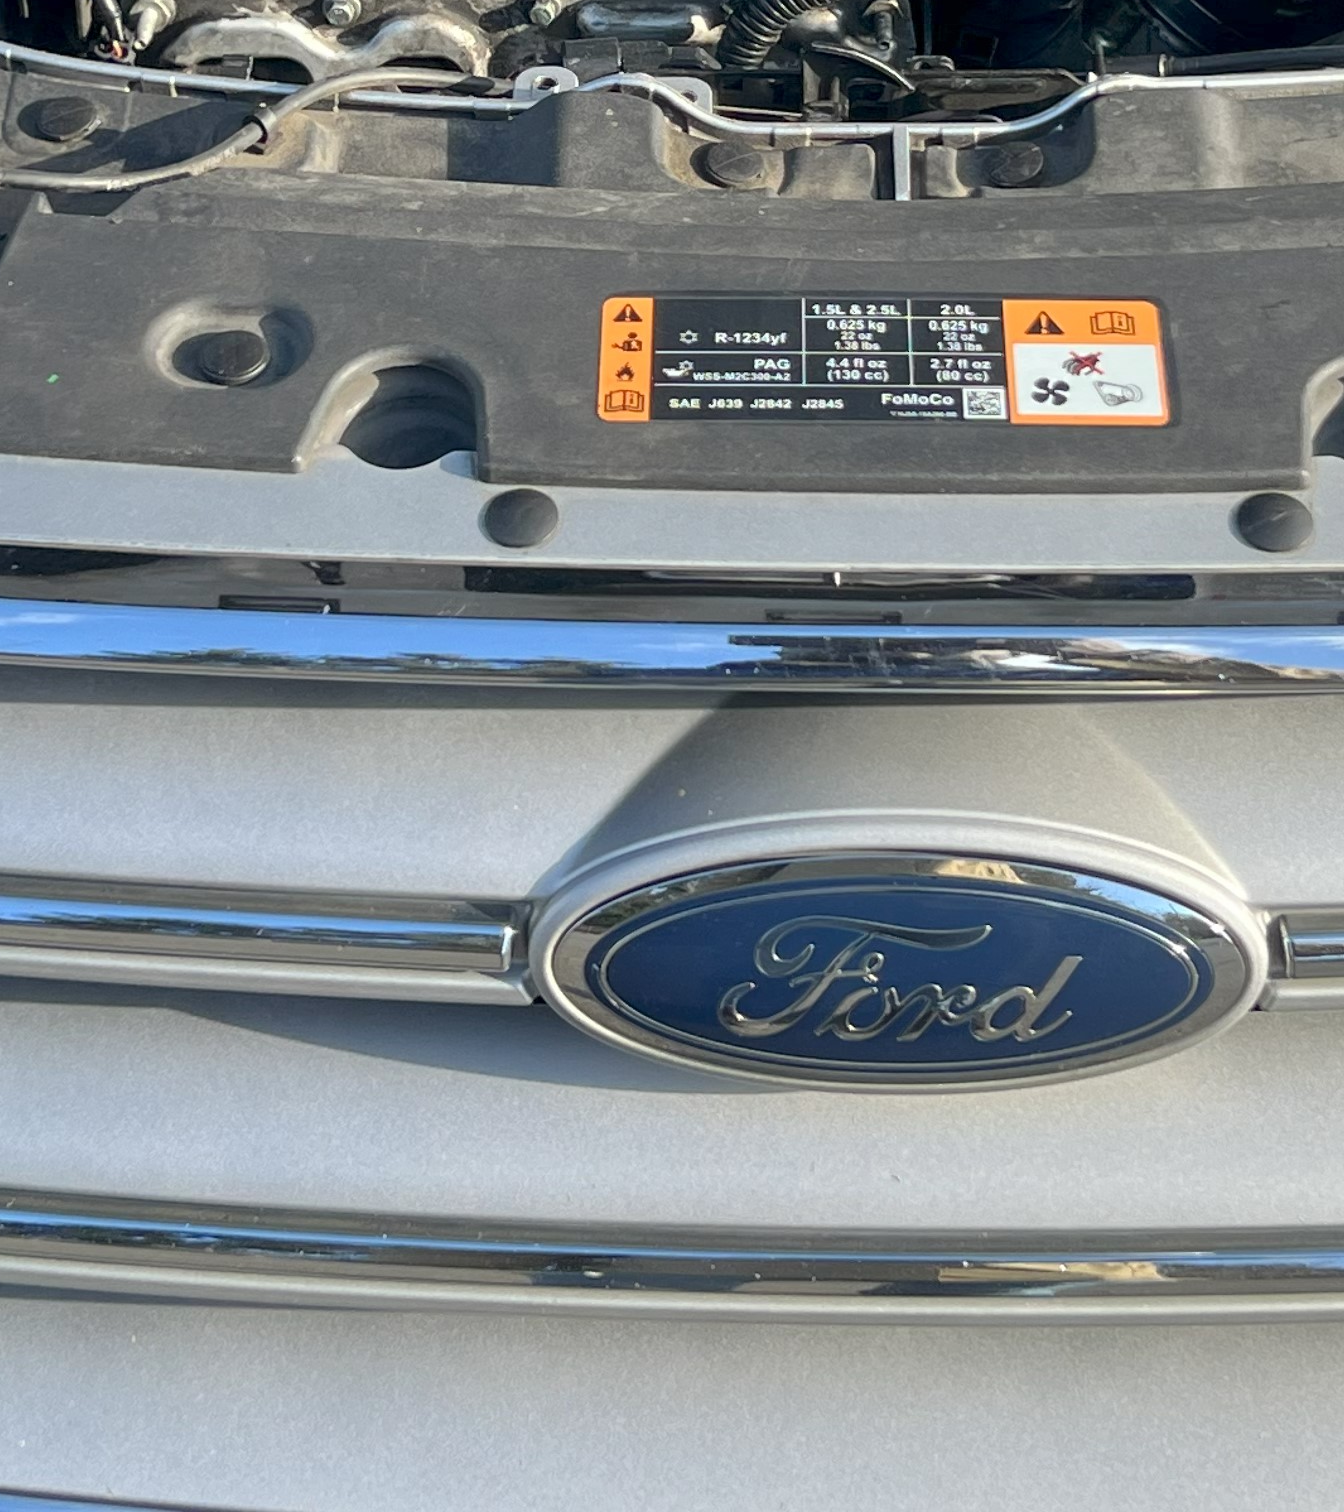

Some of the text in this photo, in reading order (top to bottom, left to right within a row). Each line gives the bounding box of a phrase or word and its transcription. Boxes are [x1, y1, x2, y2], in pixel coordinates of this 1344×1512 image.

[811, 303, 902, 316] 1.5L & 2.5L
[940, 304, 976, 316] 2.0L
[826, 319, 887, 333] 0.625 kg
[928, 320, 989, 334] 0.625 kg
[714, 331, 789, 346] R-1234yf
[840, 331, 873, 341] 22 oz
[943, 332, 957, 341] 22
[861, 341, 881, 351] lbs
[964, 342, 983, 352] lbs
[753, 358, 792, 370] PAG
[825, 358, 887, 369] 4.4 fl oz
[930, 358, 992, 370] 2.7 fl oz
[827, 369, 890, 383] (130 cc)
[936, 370, 990, 383] (80 cc)
[668, 398, 701, 409] SAE
[708, 398, 744, 409] J639
[750, 398, 793, 409] J2842
[881, 393, 955, 406] FoMoCo
[718, 915, 1083, 1043] Ford
